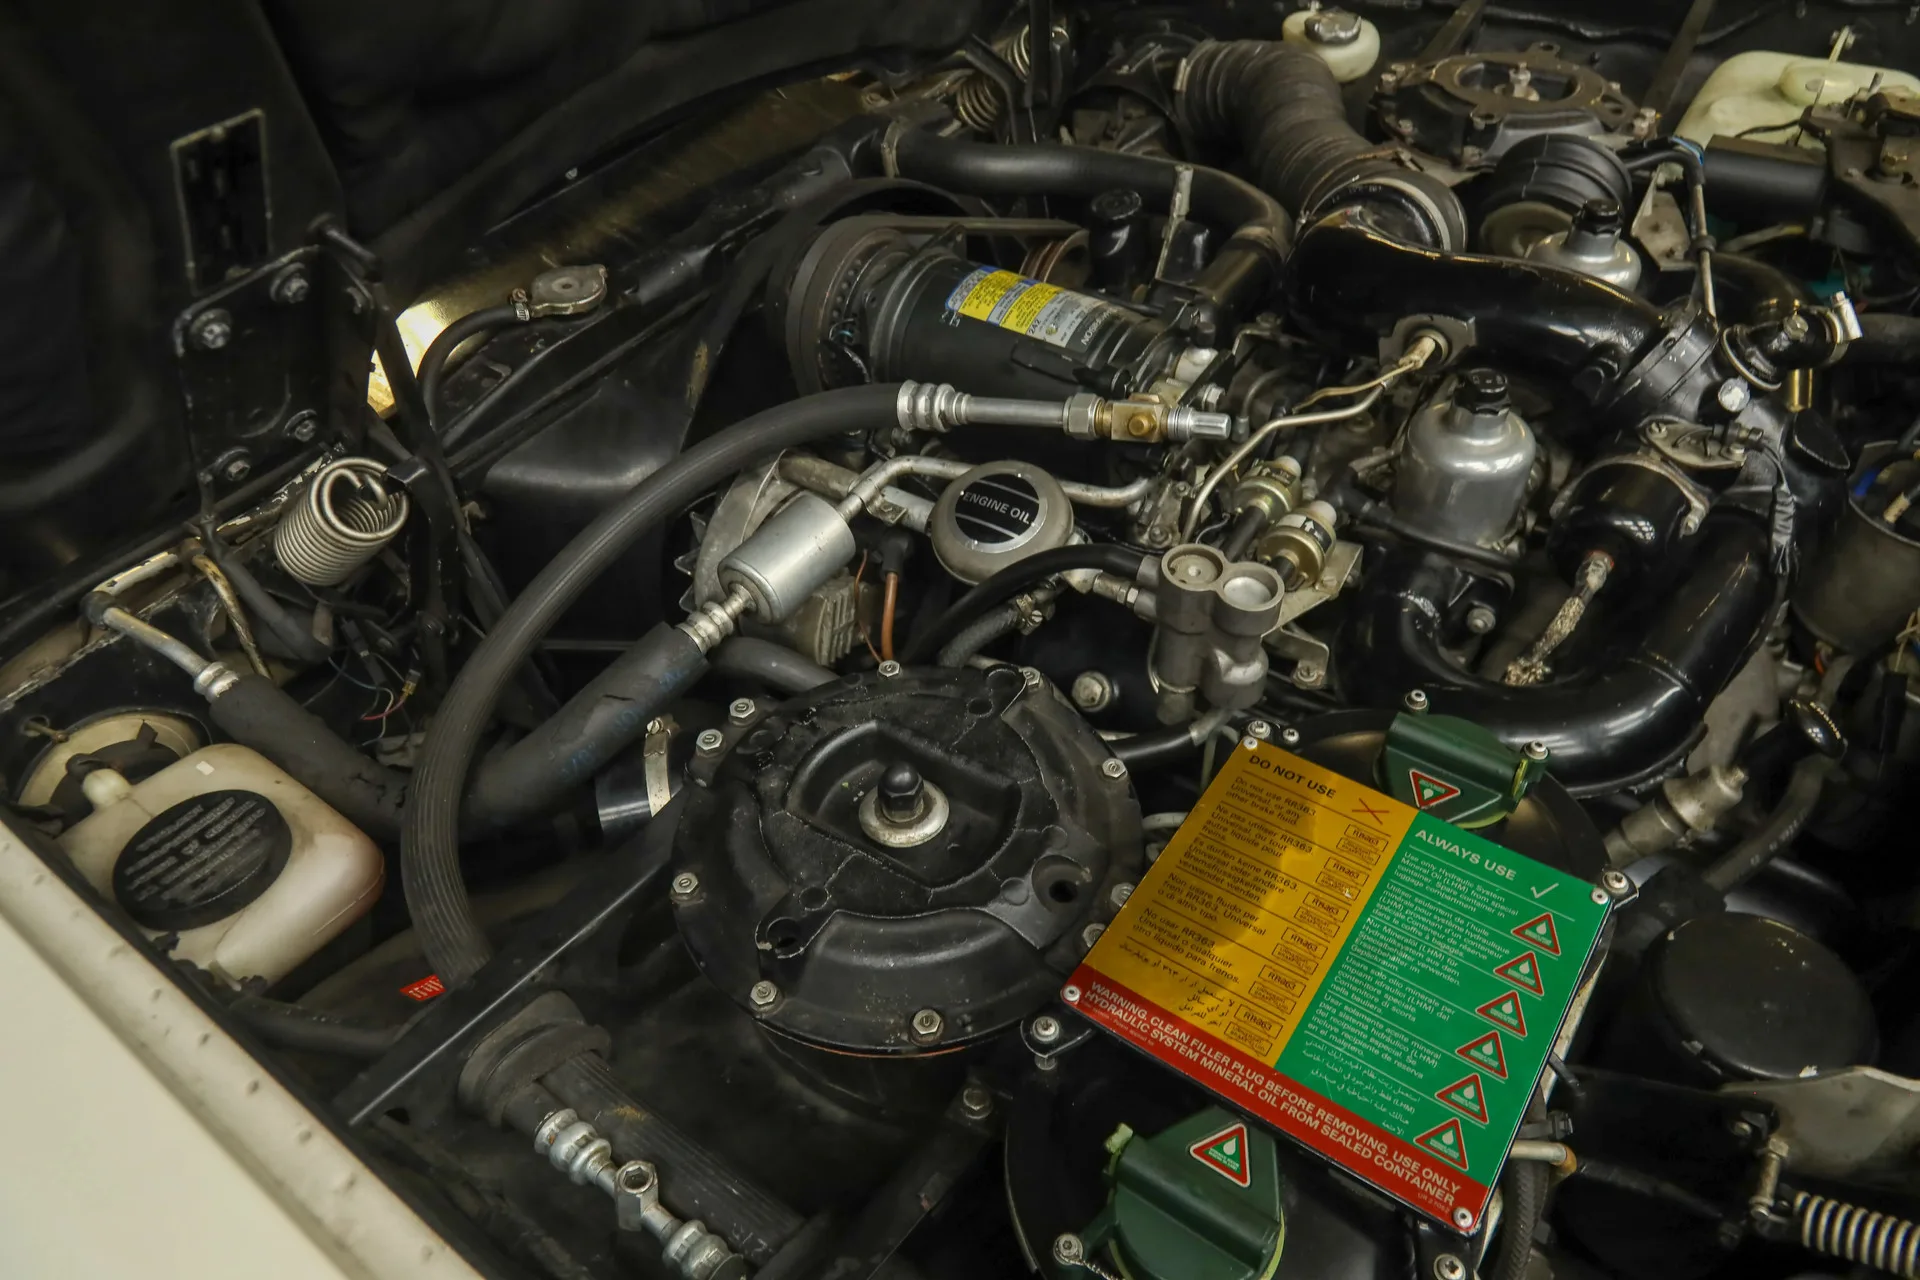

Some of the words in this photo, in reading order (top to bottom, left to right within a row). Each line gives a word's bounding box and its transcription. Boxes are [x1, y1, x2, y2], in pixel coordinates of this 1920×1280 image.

[962, 491, 1009, 514] ENGINE
[1010, 507, 1030, 525] OIL
[1247, 754, 1272, 770] DO
[1271, 764, 1306, 785] NOT
[1305, 779, 1337, 799] USE
[1413, 827, 1482, 865] ALWAYS
[1482, 858, 1517, 881] USE
[1221, 909, 1267, 936] Universal
[1082, 990, 1151, 1034] HYDRAULIC
[1148, 1027, 1200, 1062] SYSTEM
[1198, 1055, 1258, 1095] MINERAL
[1255, 1087, 1281, 1108] OIL
[1278, 1100, 1320, 1130] FROM
[1319, 1123, 1373, 1161] SEALED
[1372, 1153, 1455, 1207] CONTAINER
[1088, 981, 1150, 1020] WARNING.
[1148, 1014, 1191, 1043] CLEAN
[1189, 1037, 1231, 1066] FILLER
[1229, 1060, 1265, 1085] PLUG
[1264, 1079, 1315, 1114] BEFORE
[1314, 1107, 1391, 1157] REMOVING.
[1391, 1149, 1421, 1174] USE
[1420, 1166, 1461, 1196] ONLY
